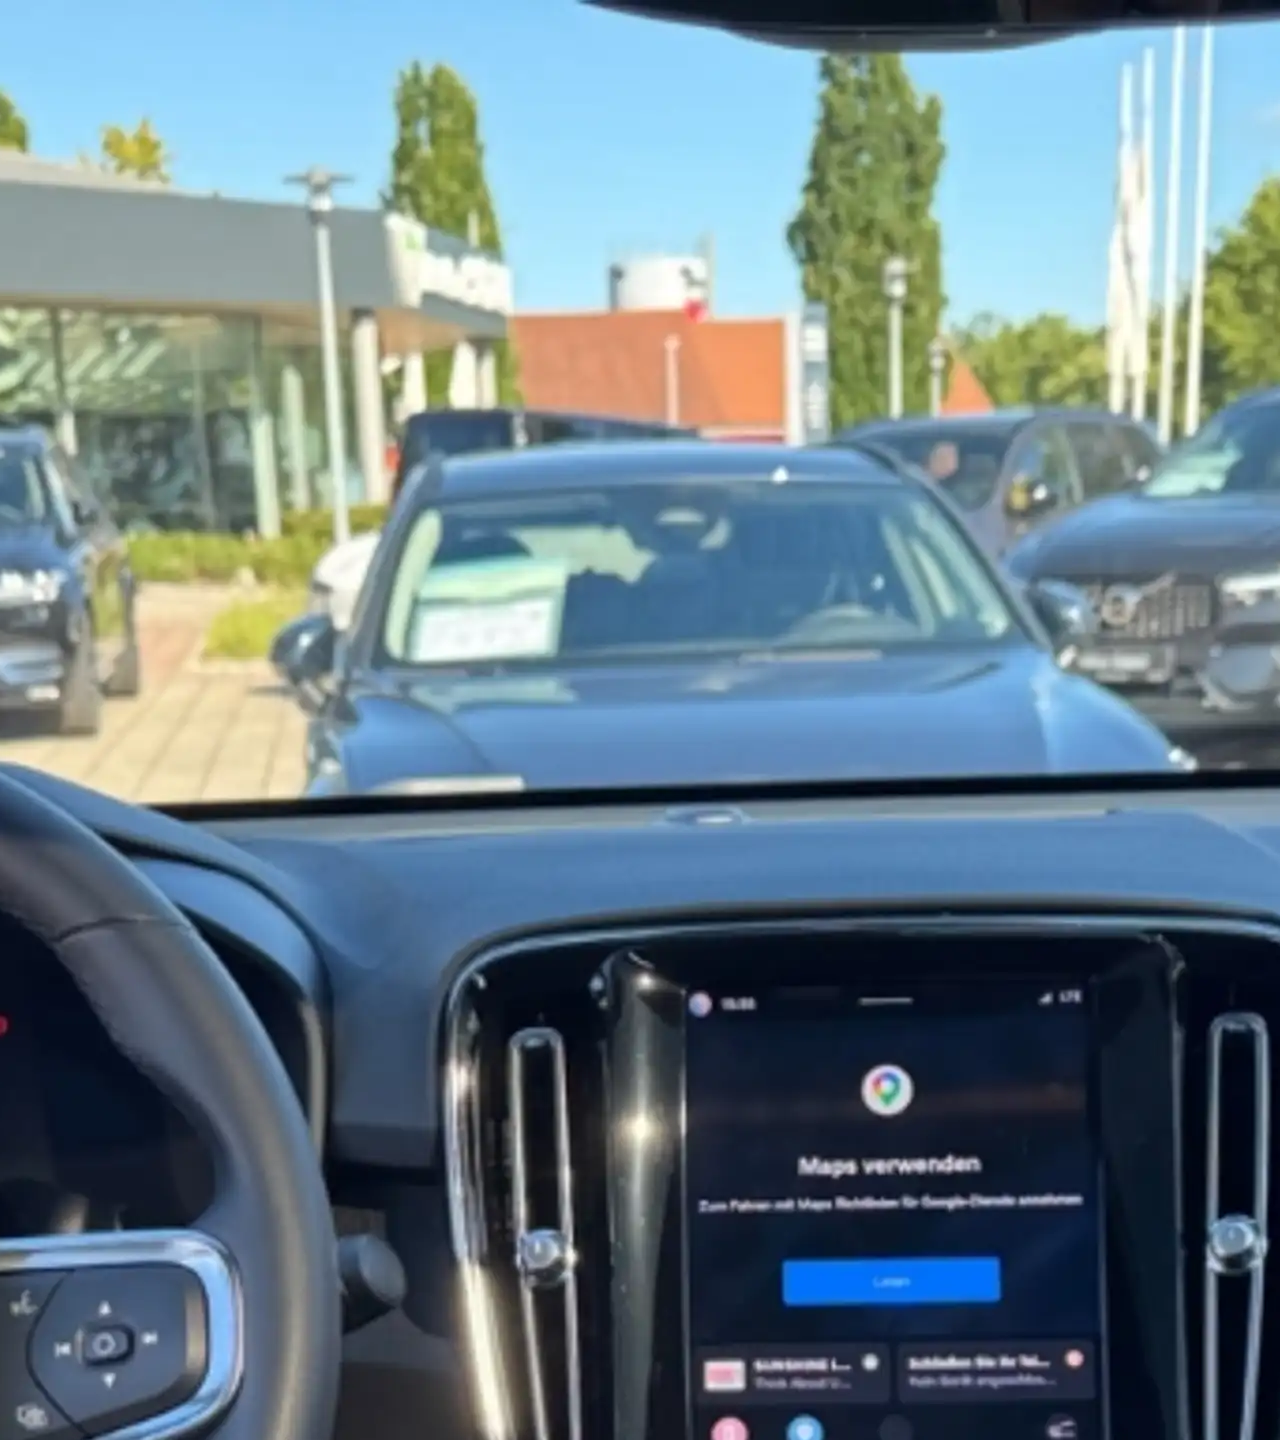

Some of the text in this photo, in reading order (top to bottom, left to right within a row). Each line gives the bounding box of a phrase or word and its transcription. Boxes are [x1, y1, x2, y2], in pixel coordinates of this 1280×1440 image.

[797, 1153, 982, 1179] Maps verwenden
[798, 1197, 832, 1213] Maps
